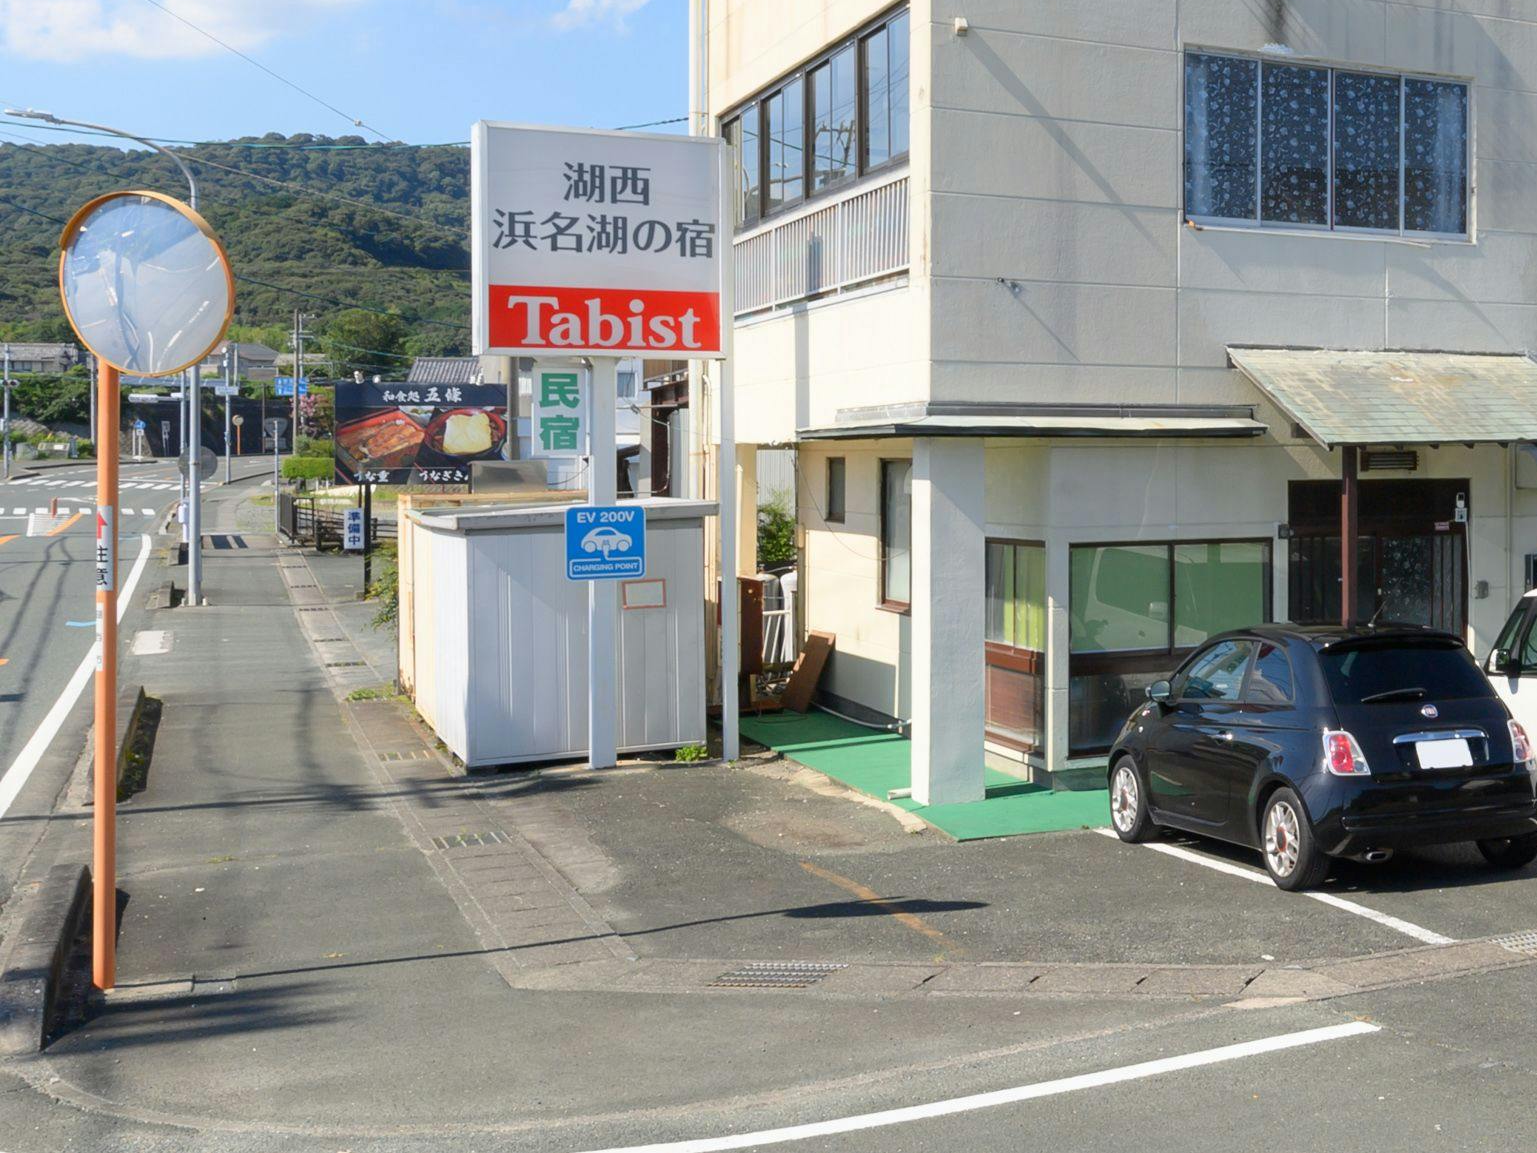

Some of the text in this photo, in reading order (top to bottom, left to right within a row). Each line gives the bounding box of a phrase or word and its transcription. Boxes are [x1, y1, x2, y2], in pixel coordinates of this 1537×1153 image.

[563, 161, 651, 206] 湖西
[492, 208, 716, 258] 浜名湖の宿
[507, 295, 702, 348] Tabist
[539, 373, 581, 450] 民宿
[347, 511, 361, 546] 準備中
[577, 510, 635, 524] EV 200V
[573, 562, 639, 572] CHARGING POINT
